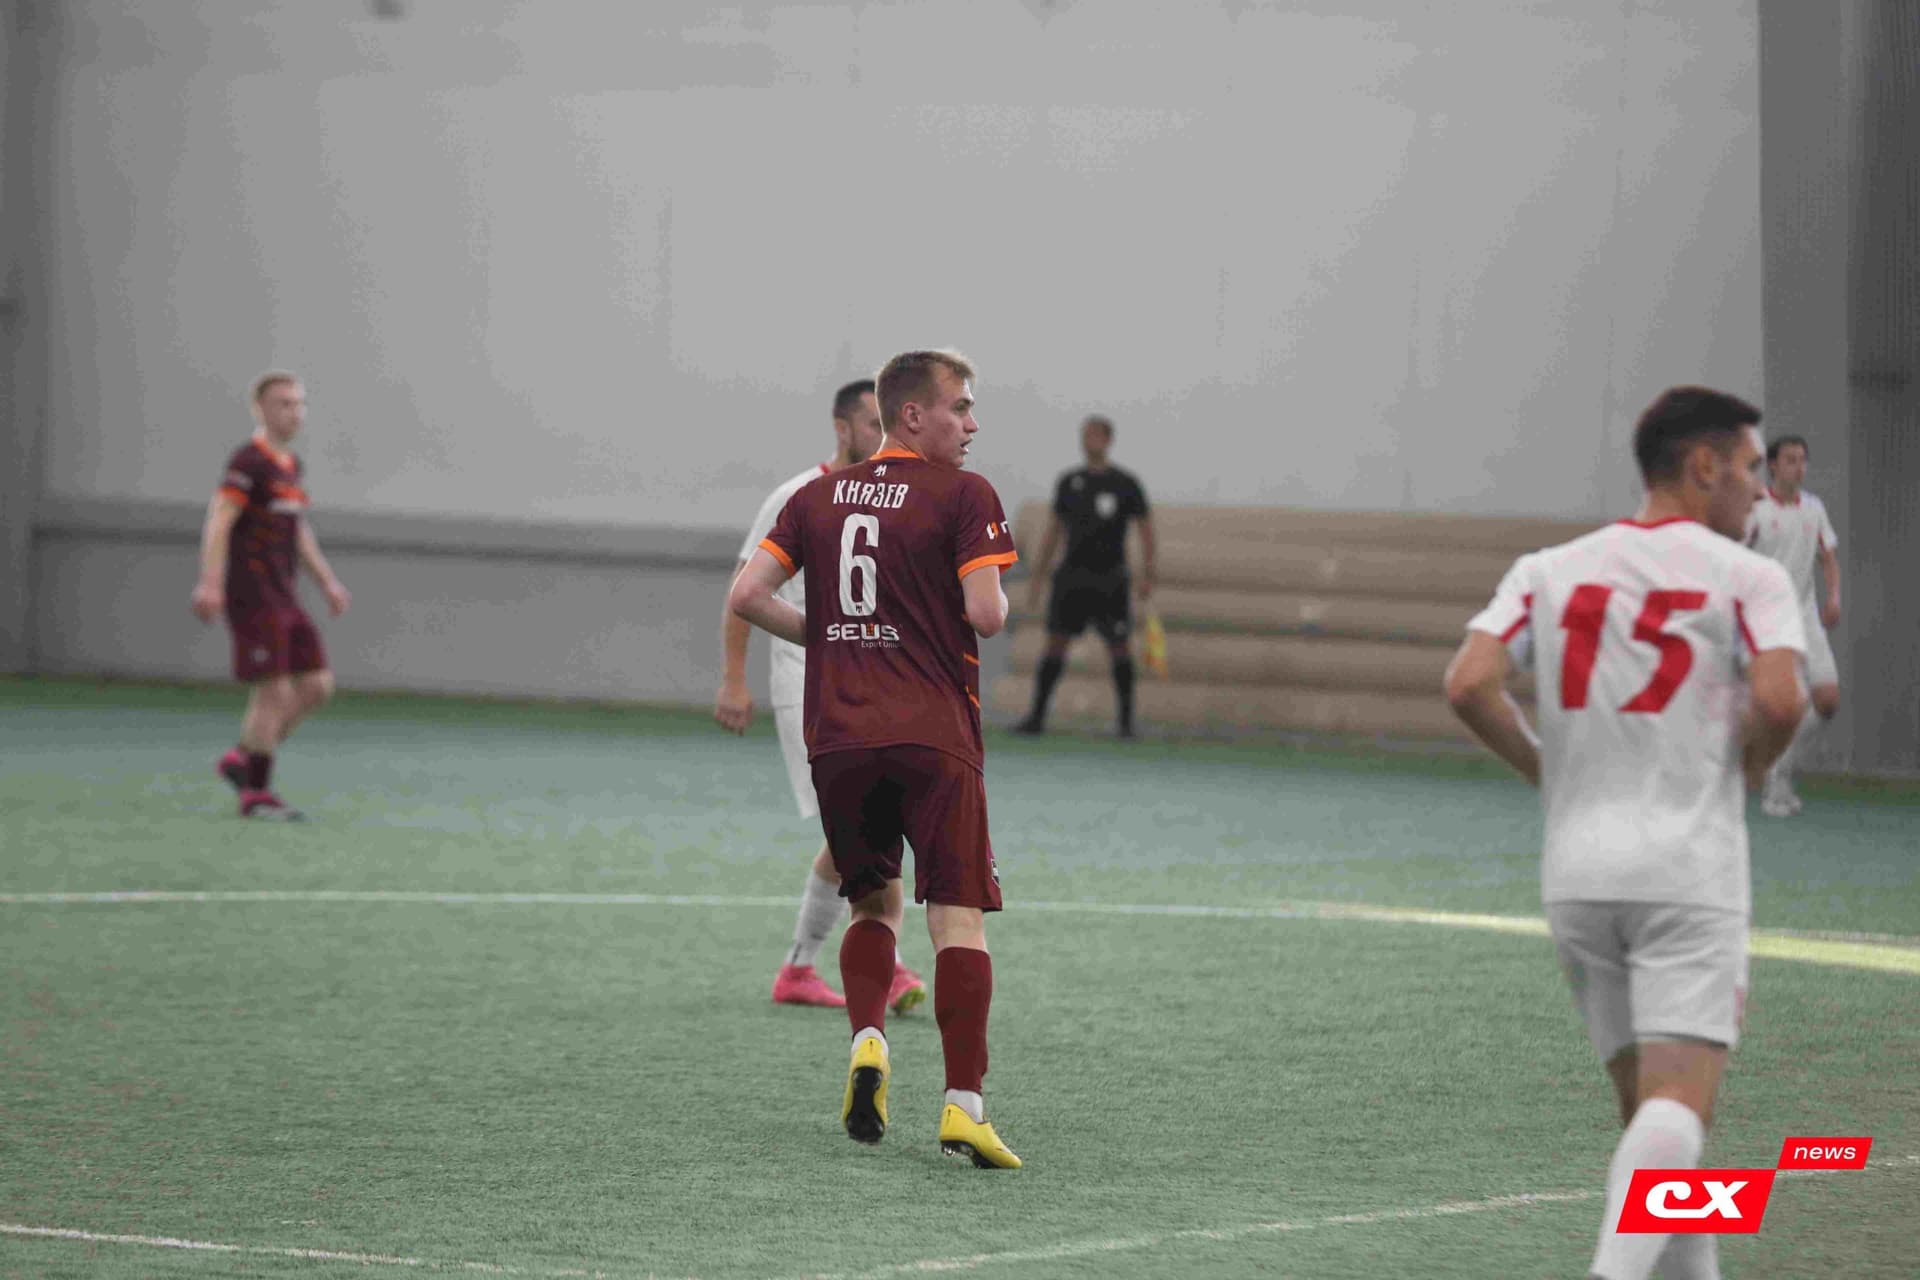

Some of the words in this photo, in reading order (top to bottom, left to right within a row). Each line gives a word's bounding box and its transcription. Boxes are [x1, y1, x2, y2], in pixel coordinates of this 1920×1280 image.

[832, 479, 909, 509] КНЯЗЕВ
[838, 512, 880, 617] 6
[826, 622, 900, 642] SEUS
[1559, 583, 1708, 714] 15
